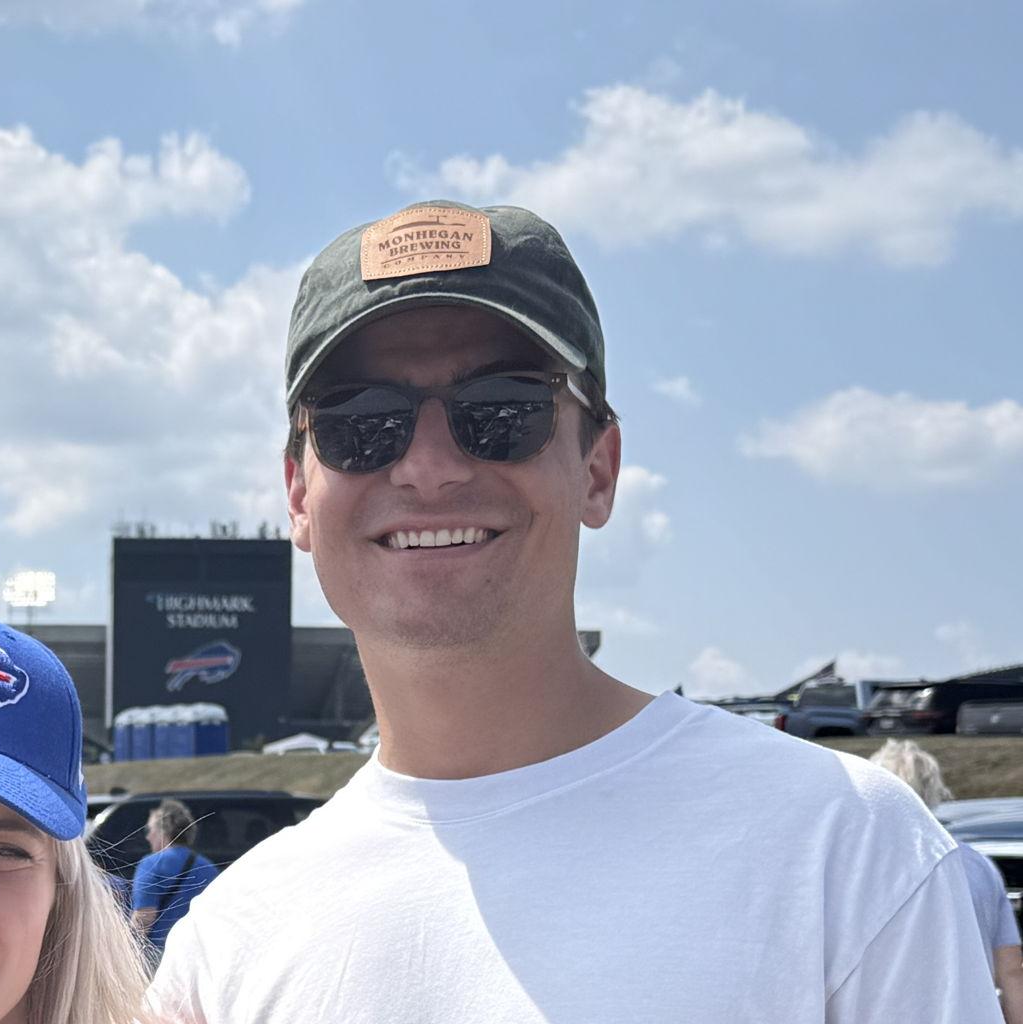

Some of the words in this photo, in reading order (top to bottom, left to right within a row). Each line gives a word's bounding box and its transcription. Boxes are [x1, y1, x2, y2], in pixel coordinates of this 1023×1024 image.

[378, 230, 474, 251] MONHEGAN
[389, 240, 461, 257] BREWING
[156, 595, 255, 612] HIGHMARK
[166, 613, 239, 629] STADIUM
